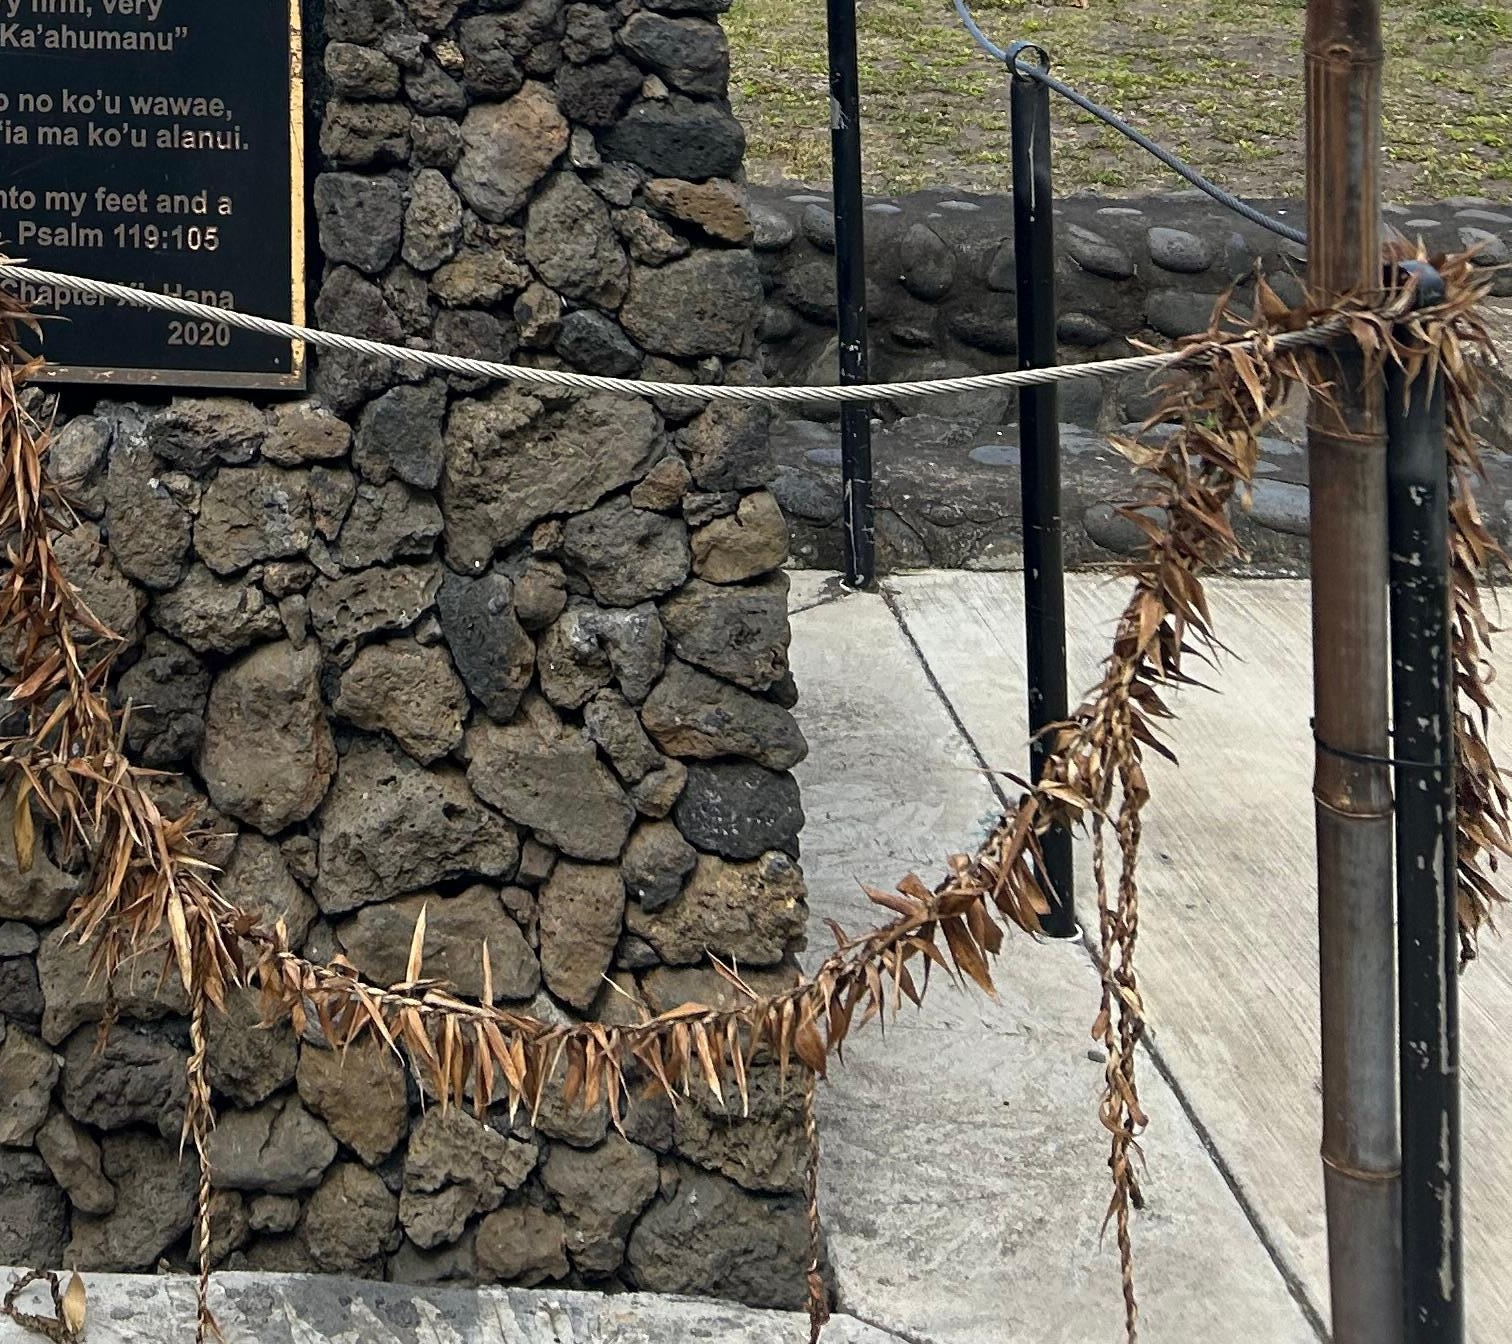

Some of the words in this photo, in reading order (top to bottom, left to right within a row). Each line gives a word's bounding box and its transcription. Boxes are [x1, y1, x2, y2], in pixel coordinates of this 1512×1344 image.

[18, 93, 53, 113] no
[129, 95, 232, 122] wawae,
[37, 126, 79, 146] ma
[156, 123, 249, 150] alanui.
[45, 191, 87, 217] my
[94, 186, 148, 213] feet
[156, 189, 208, 215] and
[217, 195, 233, 216] a
[18, 220, 104, 249] Psalm
[112, 223, 221, 252] 119:105
[167, 320, 232, 347] 2020
